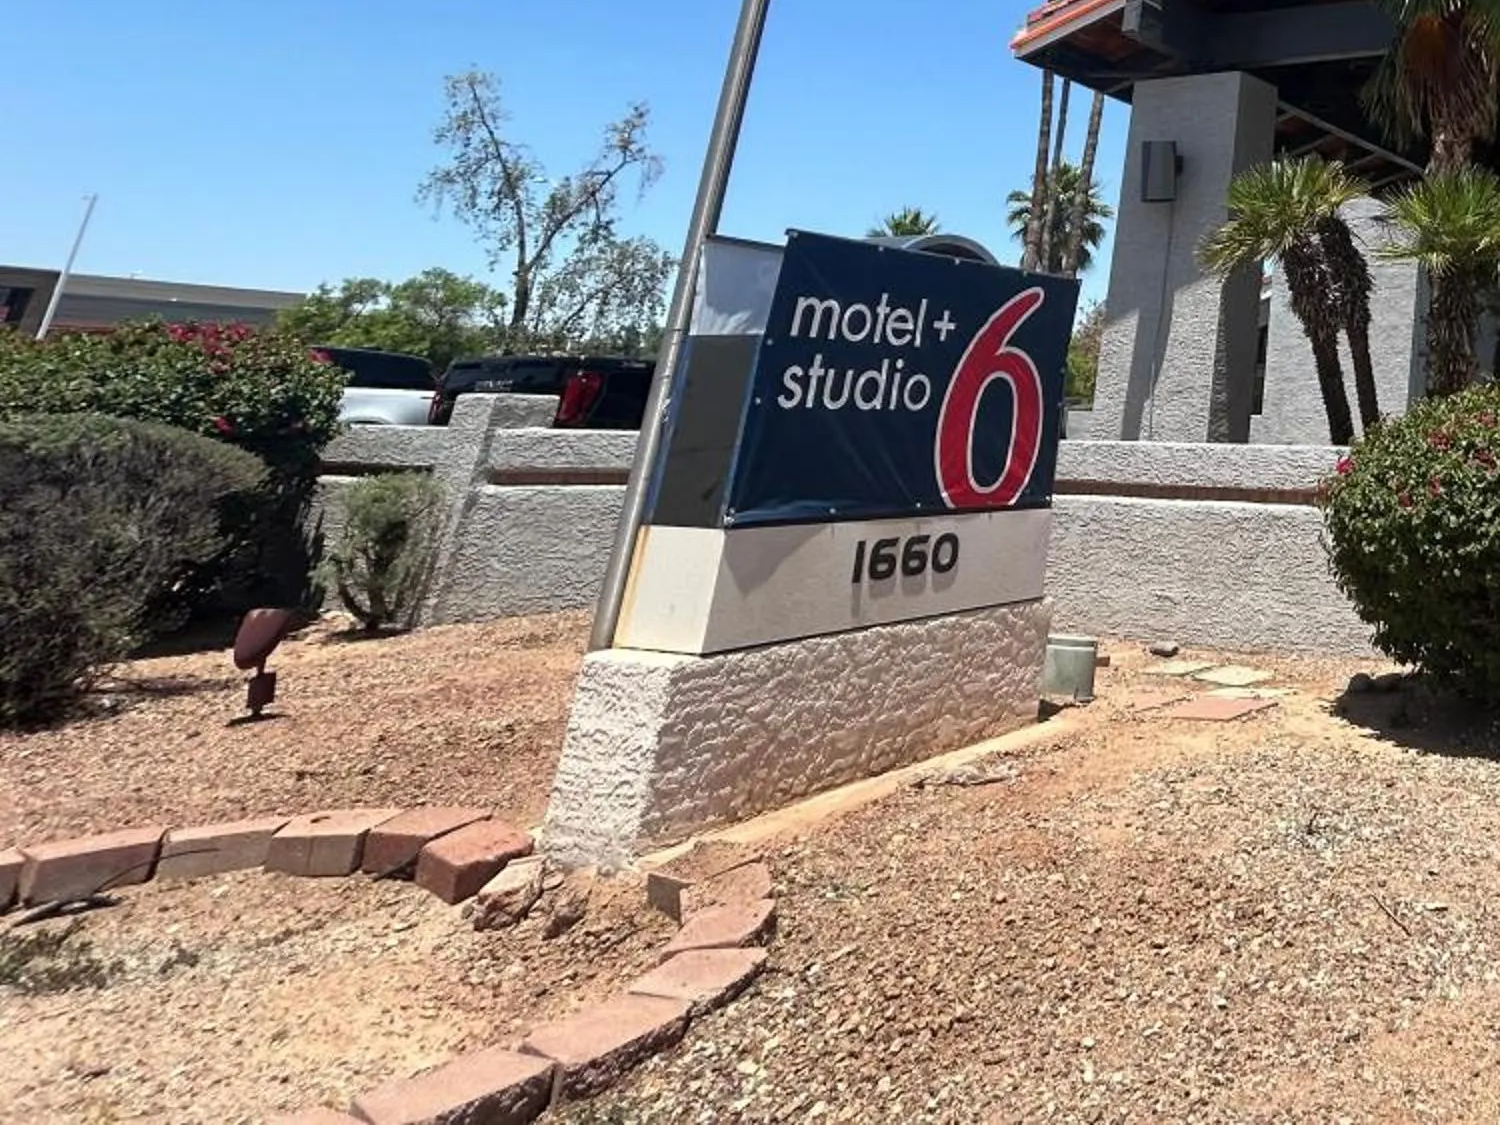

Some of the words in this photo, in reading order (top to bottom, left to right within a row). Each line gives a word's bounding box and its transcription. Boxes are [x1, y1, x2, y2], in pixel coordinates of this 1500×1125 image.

[777, 354, 932, 412] studio
[934, 286, 1045, 509] 6
[851, 532, 960, 584] 1660
